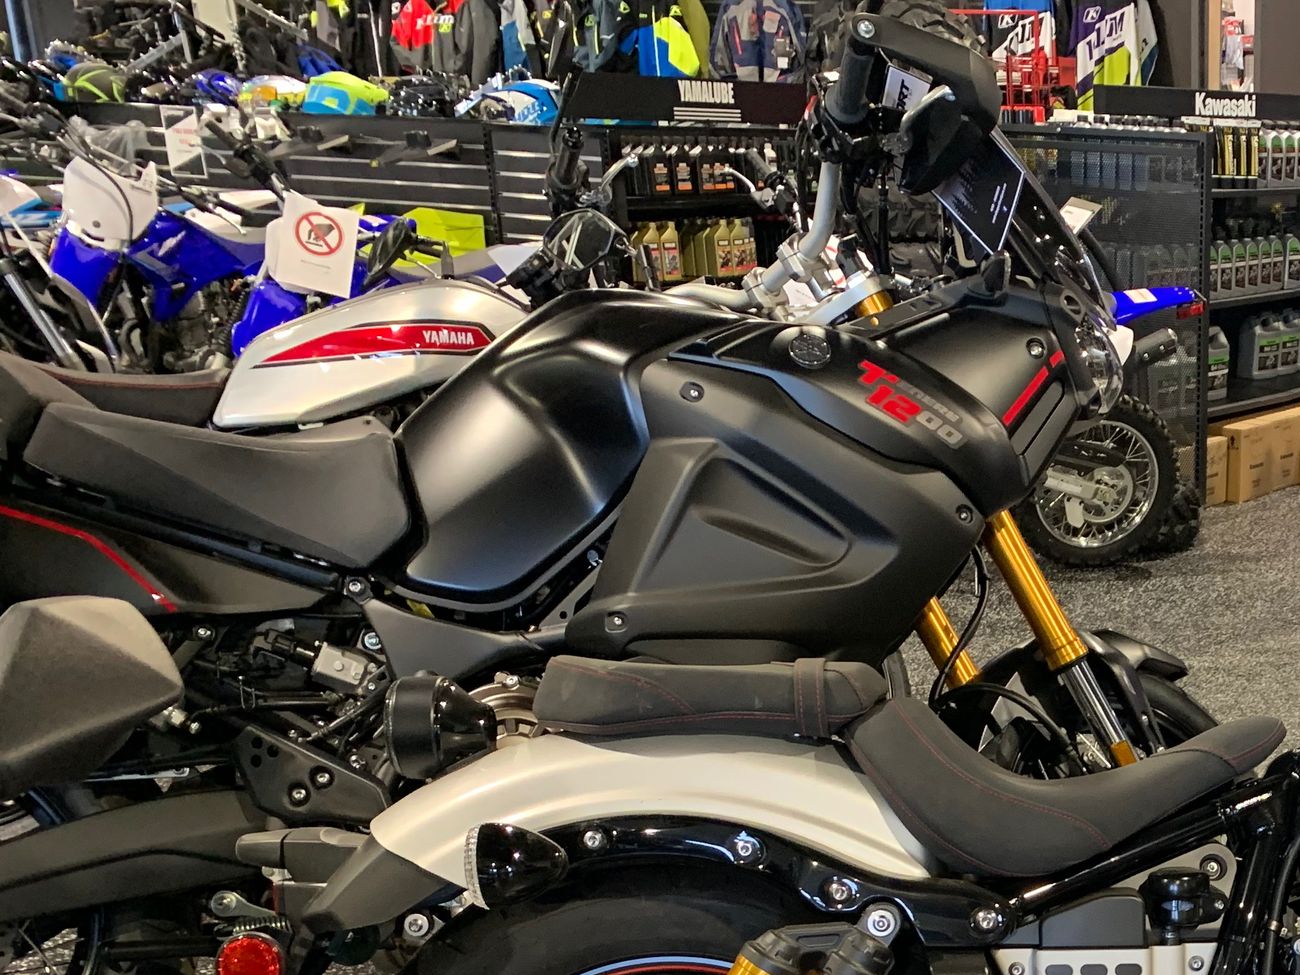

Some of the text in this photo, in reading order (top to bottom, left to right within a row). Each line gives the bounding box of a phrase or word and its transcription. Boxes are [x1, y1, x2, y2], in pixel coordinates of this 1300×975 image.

[677, 80, 735, 104] YAMALUBE
[1195, 92, 1257, 117] Kawasaki
[422, 330, 475, 345] YAMAHA
